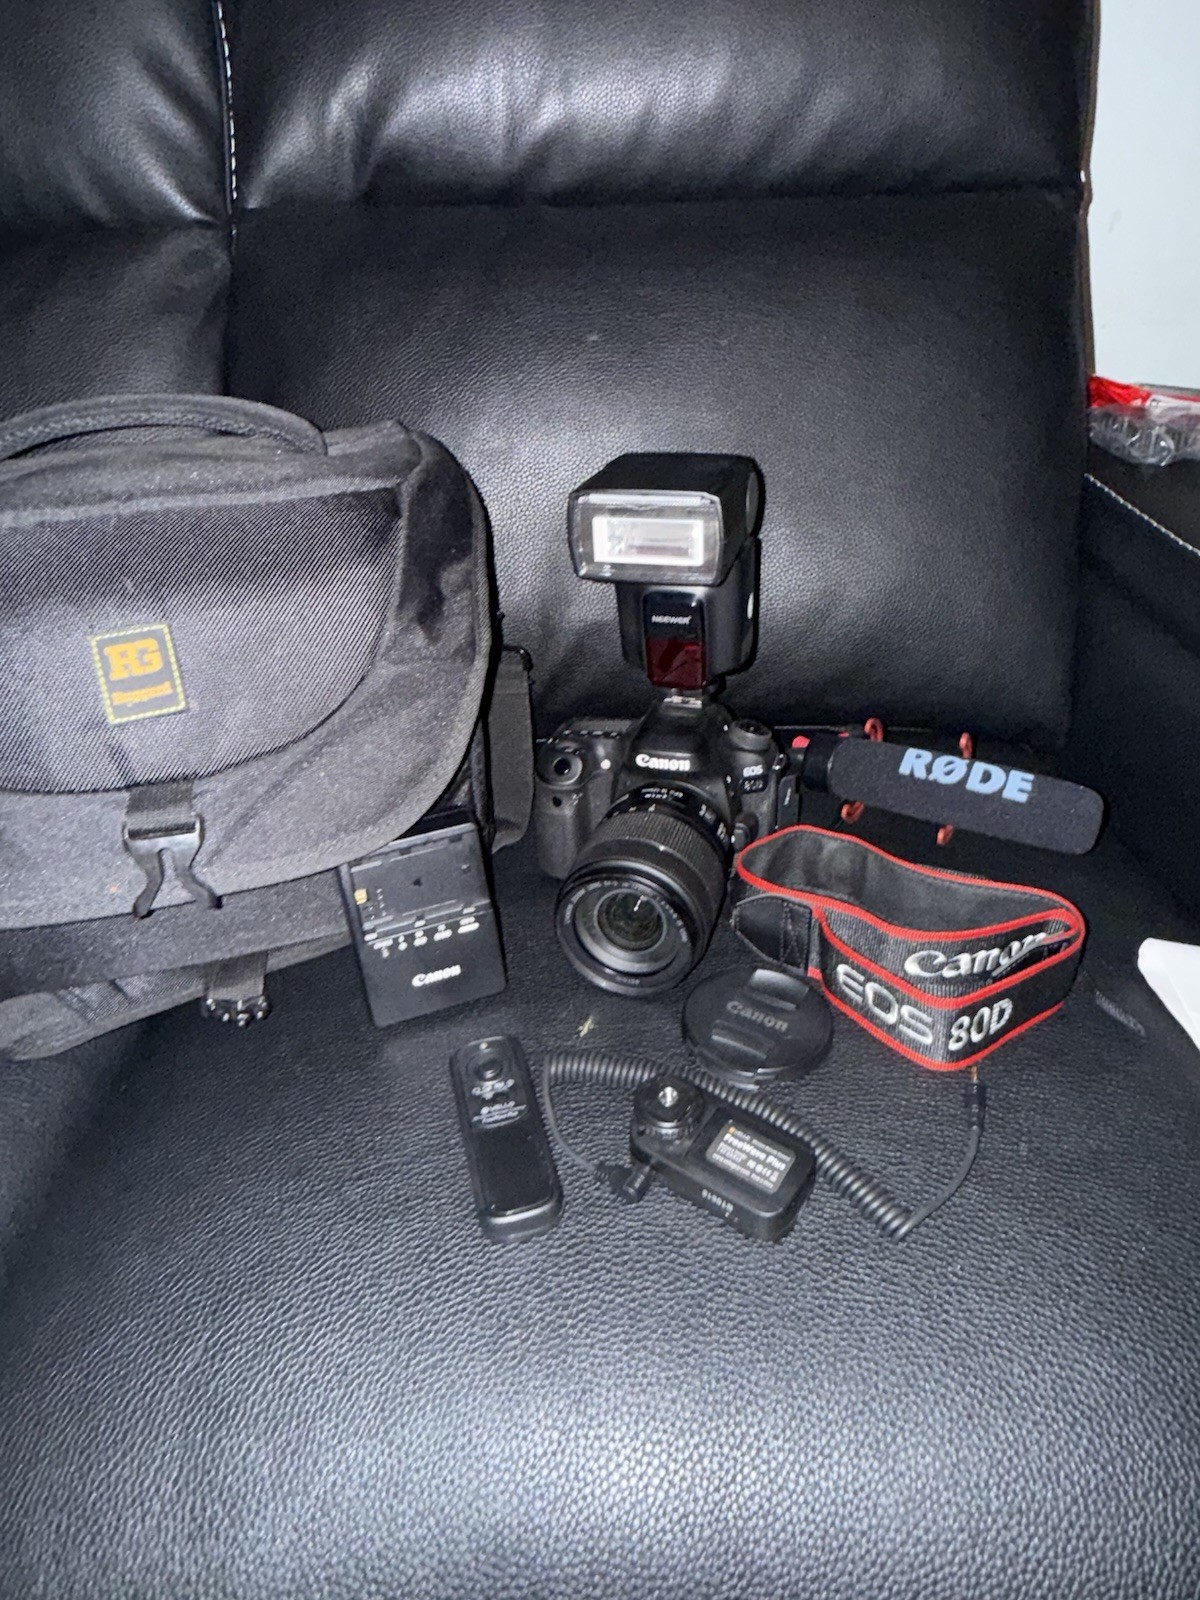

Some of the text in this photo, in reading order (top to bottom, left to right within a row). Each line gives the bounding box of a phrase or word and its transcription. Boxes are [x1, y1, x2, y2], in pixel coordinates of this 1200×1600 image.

[104, 637, 163, 681] RG
[635, 753, 691, 771] Canon
[899, 747, 1034, 803] RØDE
[412, 964, 461, 987] Canon
[726, 1001, 788, 1032] Canon
[836, 963, 1013, 1050] EOS 80D
